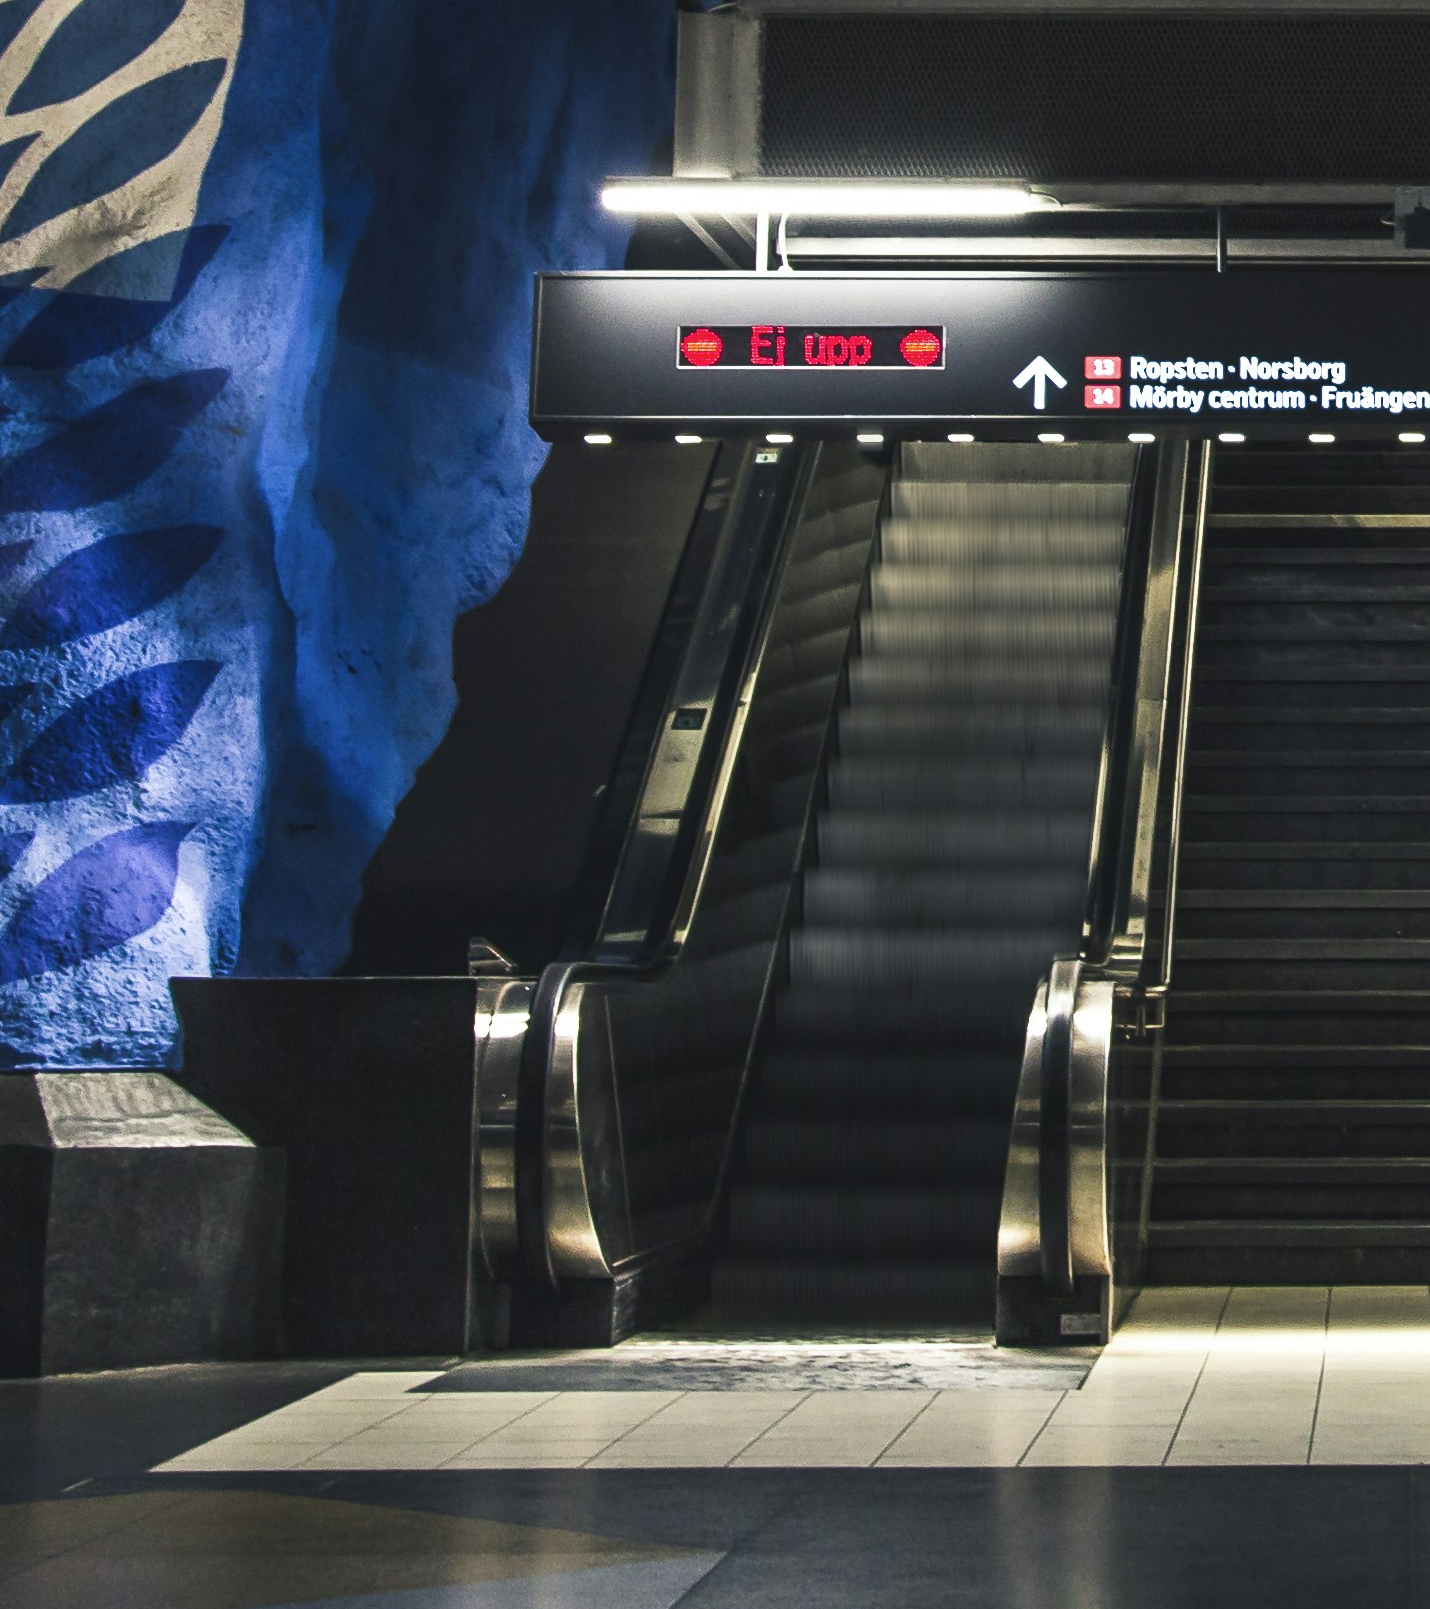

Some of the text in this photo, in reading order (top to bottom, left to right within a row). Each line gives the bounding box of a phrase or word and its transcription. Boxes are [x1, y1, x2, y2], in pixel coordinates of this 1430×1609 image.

[1093, 356, 1346, 385] 13 Ropsten Norsborg
[1092, 384, 1430, 414] 14 Mörby centrum Fruängen
